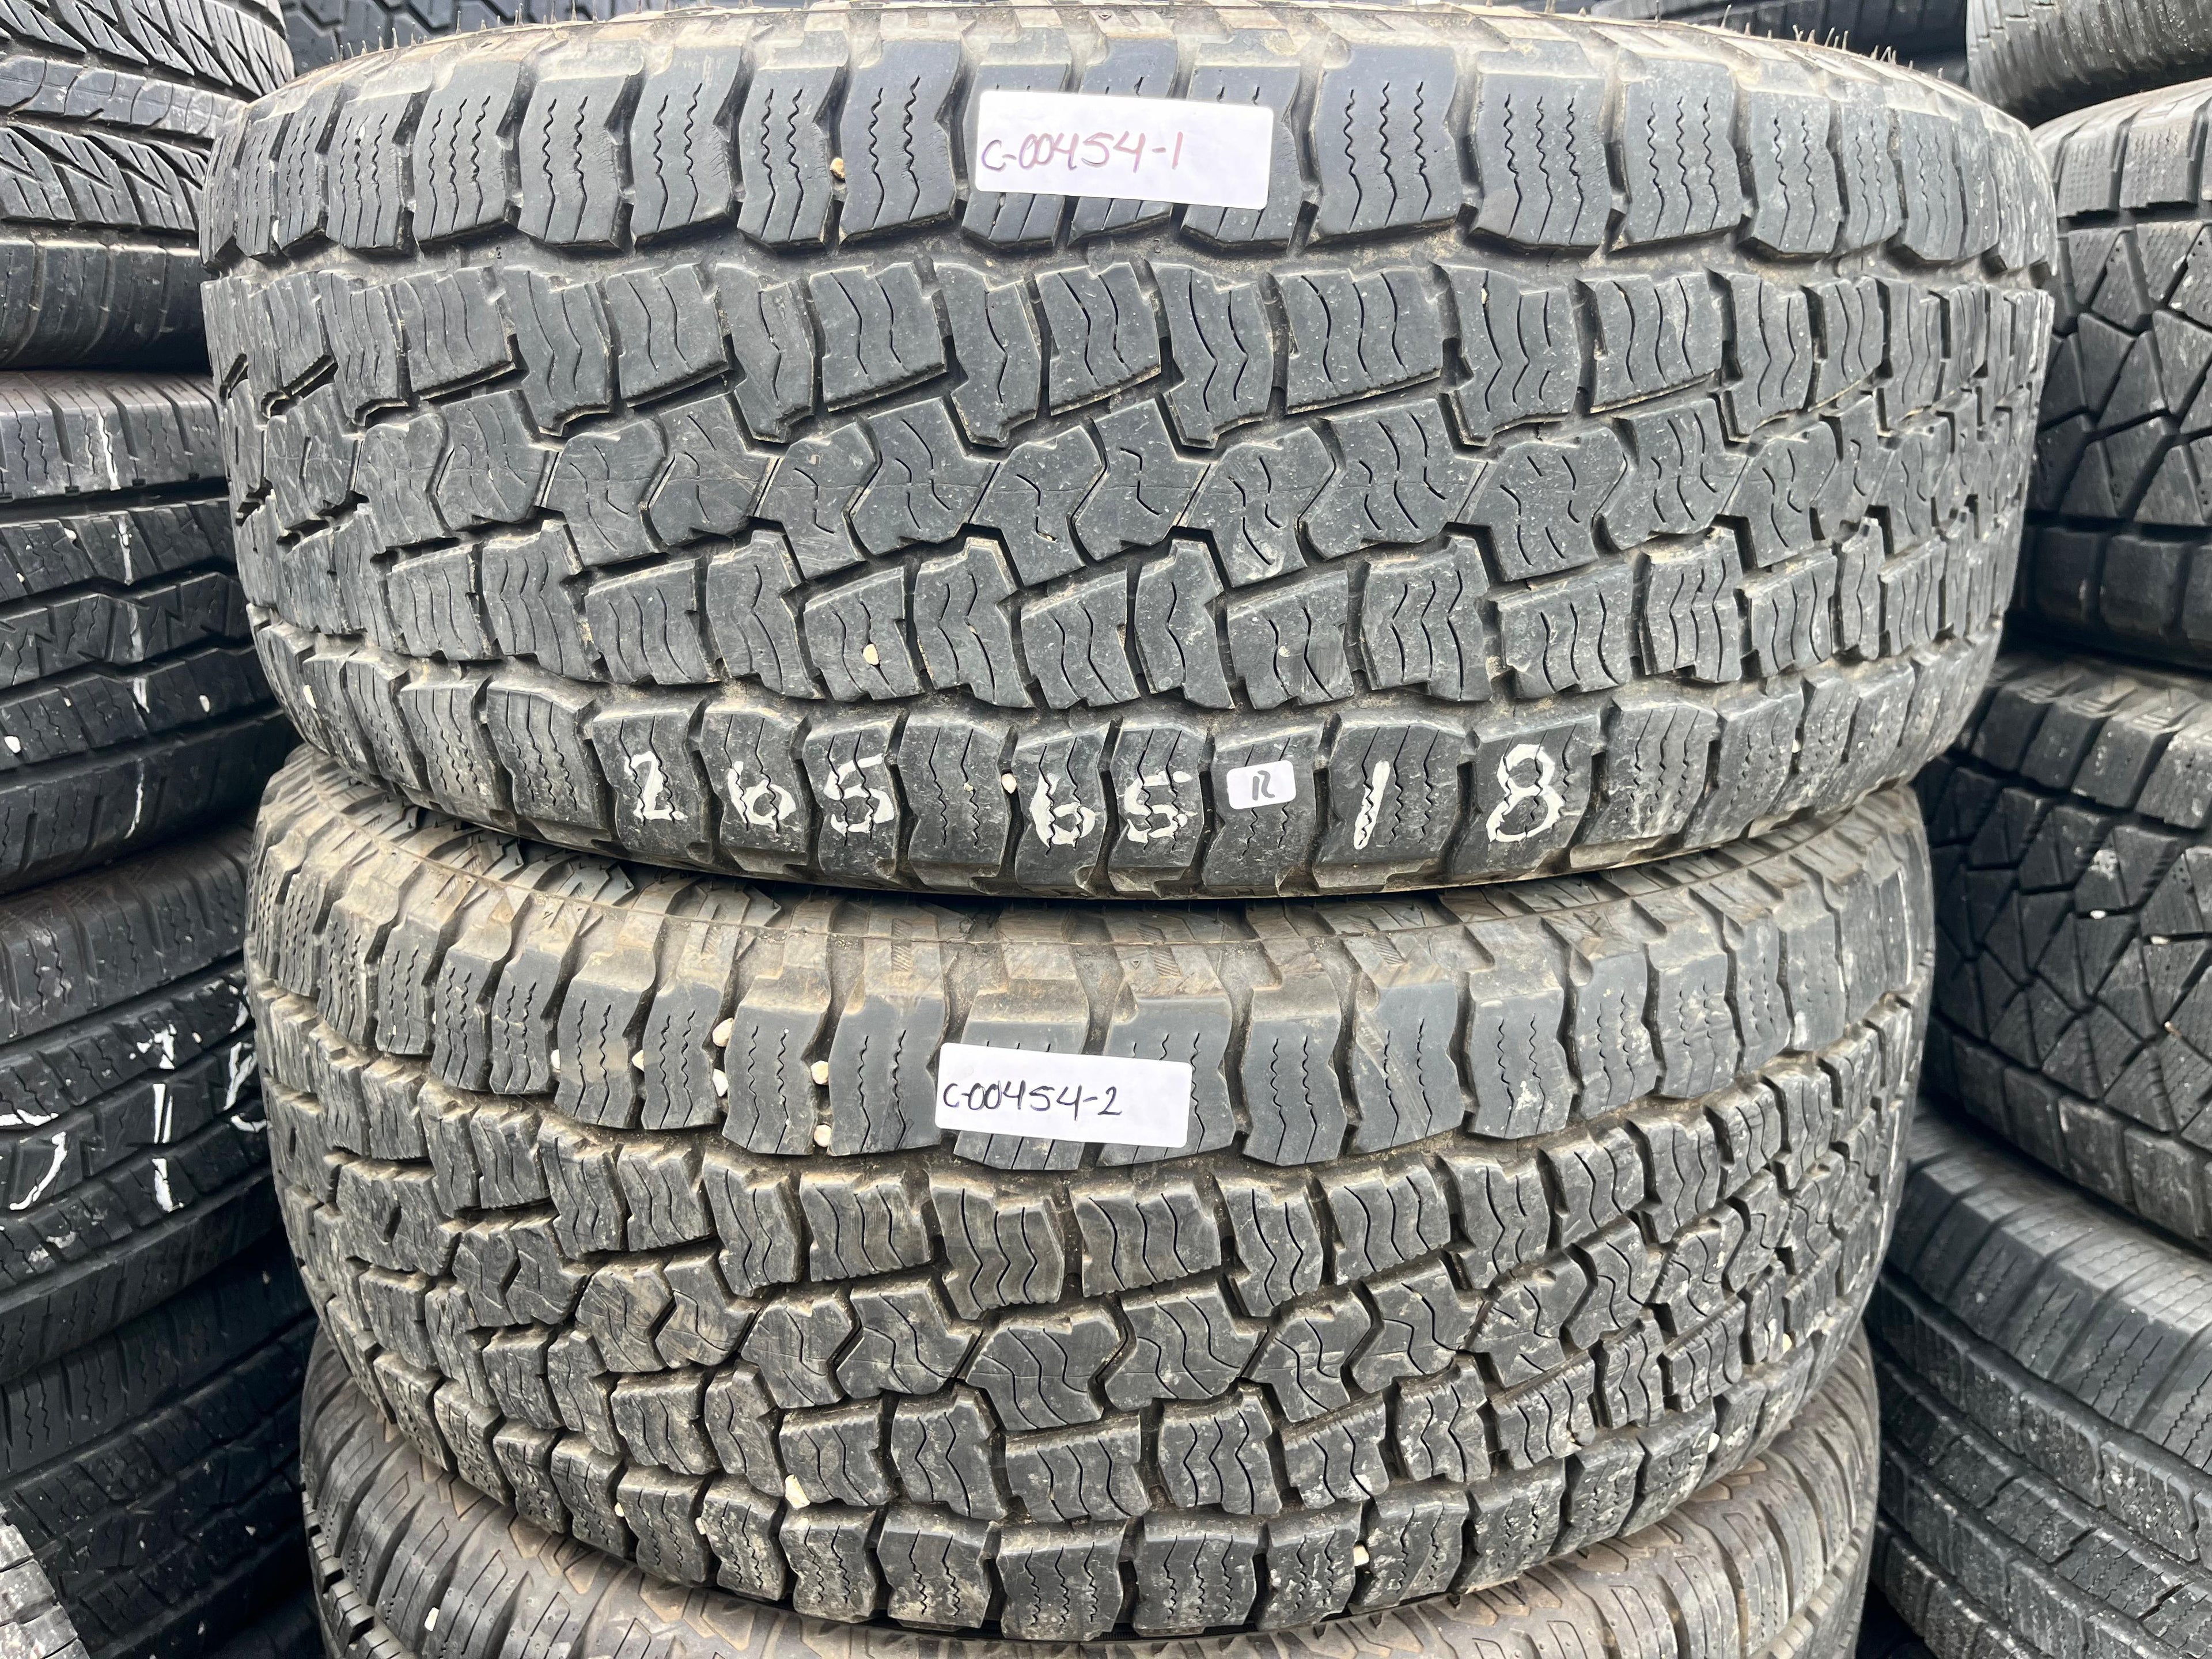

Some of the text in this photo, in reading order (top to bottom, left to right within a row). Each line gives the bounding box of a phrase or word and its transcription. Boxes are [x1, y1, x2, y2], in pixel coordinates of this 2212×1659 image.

[980, 131, 1183, 173] C-00454-1
[624, 751, 895, 836] 265
[1029, 770, 1193, 848] 65
[1352, 743, 1565, 851] 18
[942, 1080, 1123, 1122] C-00454-2
